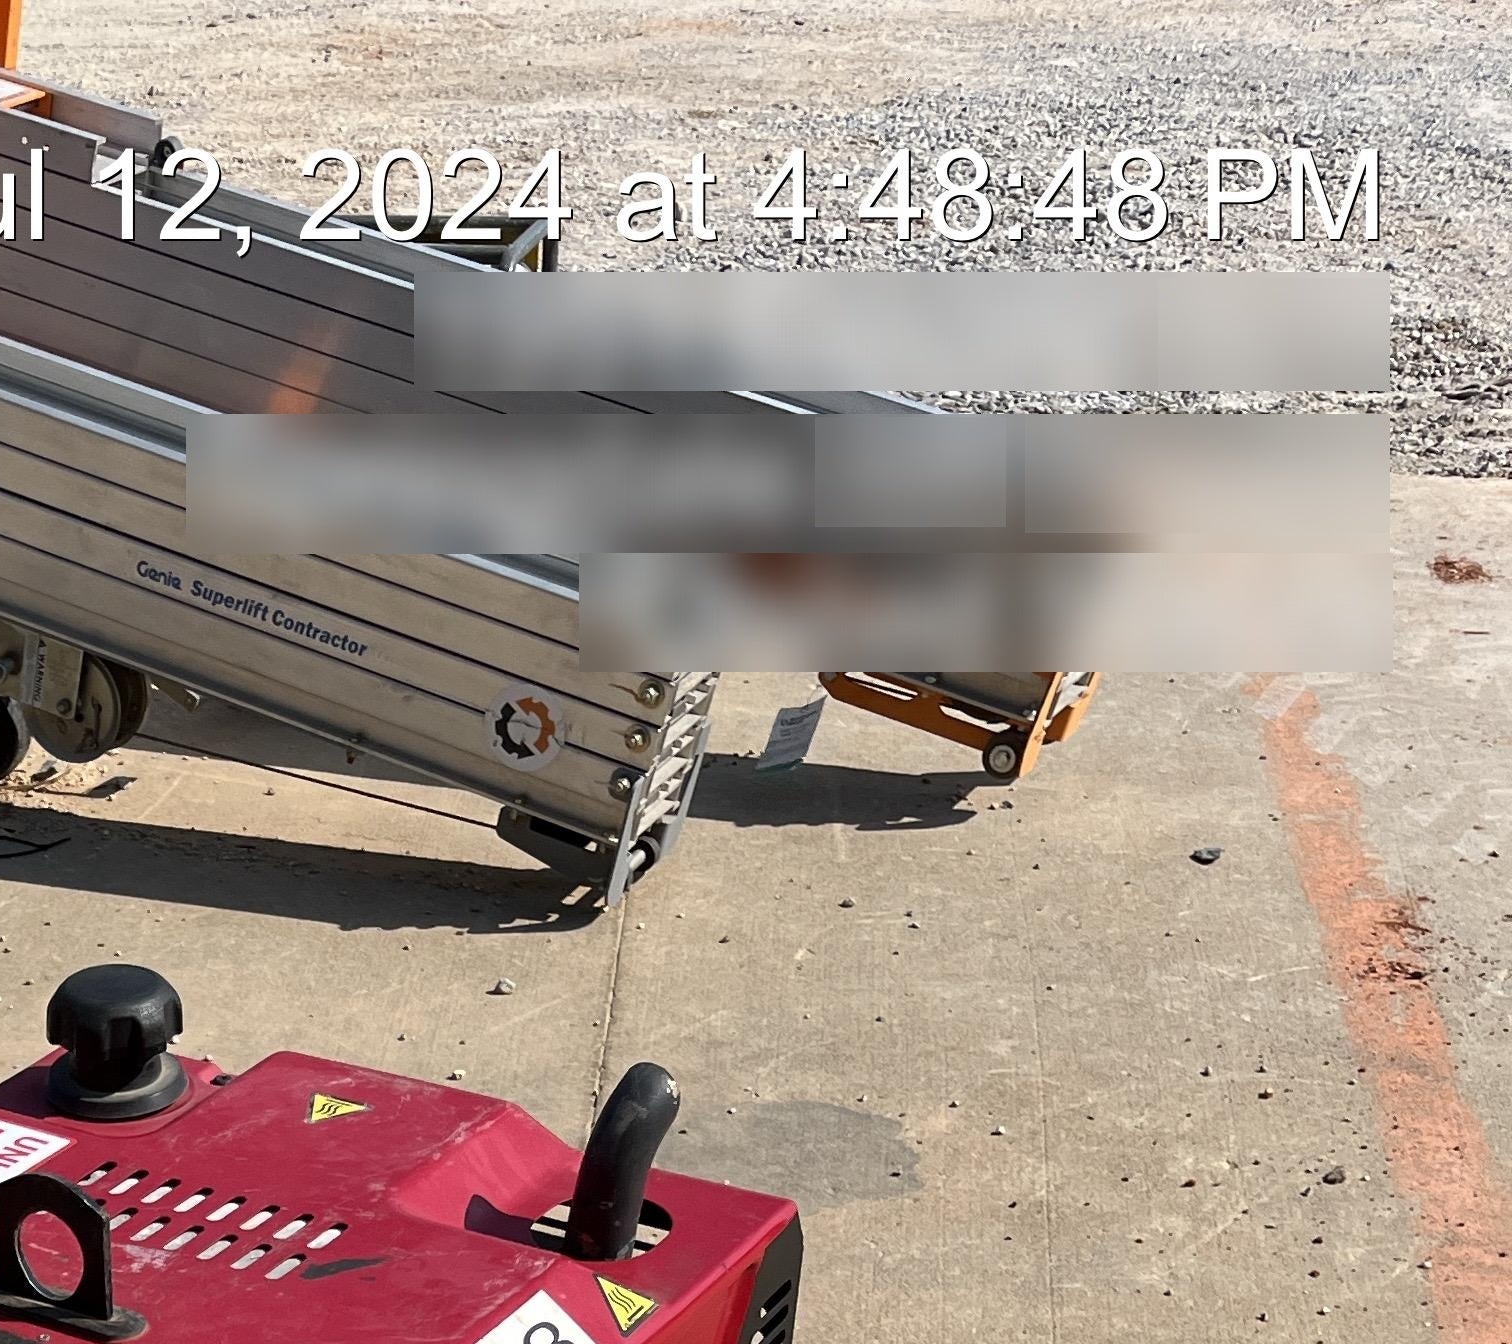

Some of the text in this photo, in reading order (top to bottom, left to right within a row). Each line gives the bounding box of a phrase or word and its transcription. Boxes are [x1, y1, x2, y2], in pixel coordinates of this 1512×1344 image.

[136, 560, 369, 656] Genie Superlift Contractor
